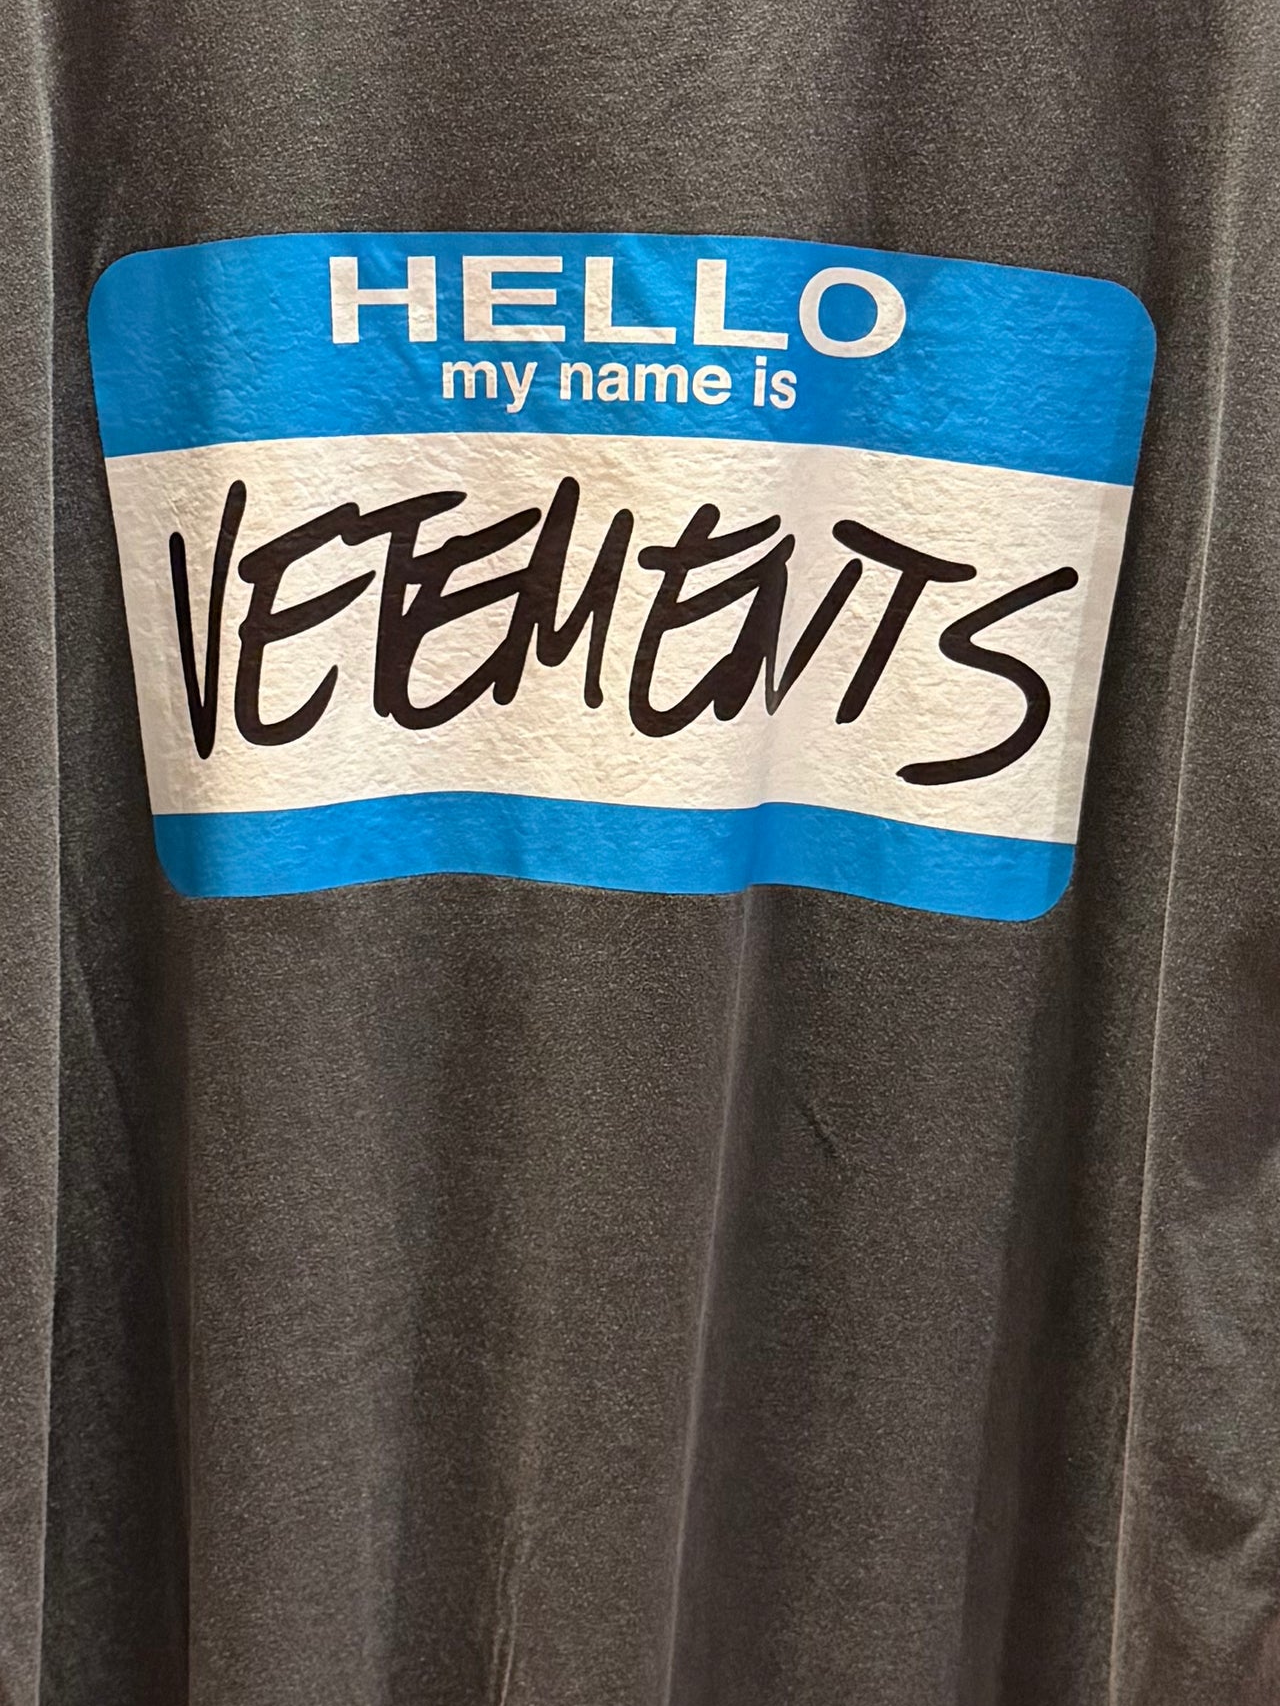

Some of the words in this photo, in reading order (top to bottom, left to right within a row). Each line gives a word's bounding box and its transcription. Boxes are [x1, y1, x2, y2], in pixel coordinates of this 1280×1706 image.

[328, 254, 907, 359] HELLO
[441, 360, 539, 414] my
[559, 361, 733, 406] name
[752, 354, 798, 410] is
[169, 476, 1080, 786] VETEMENTS
